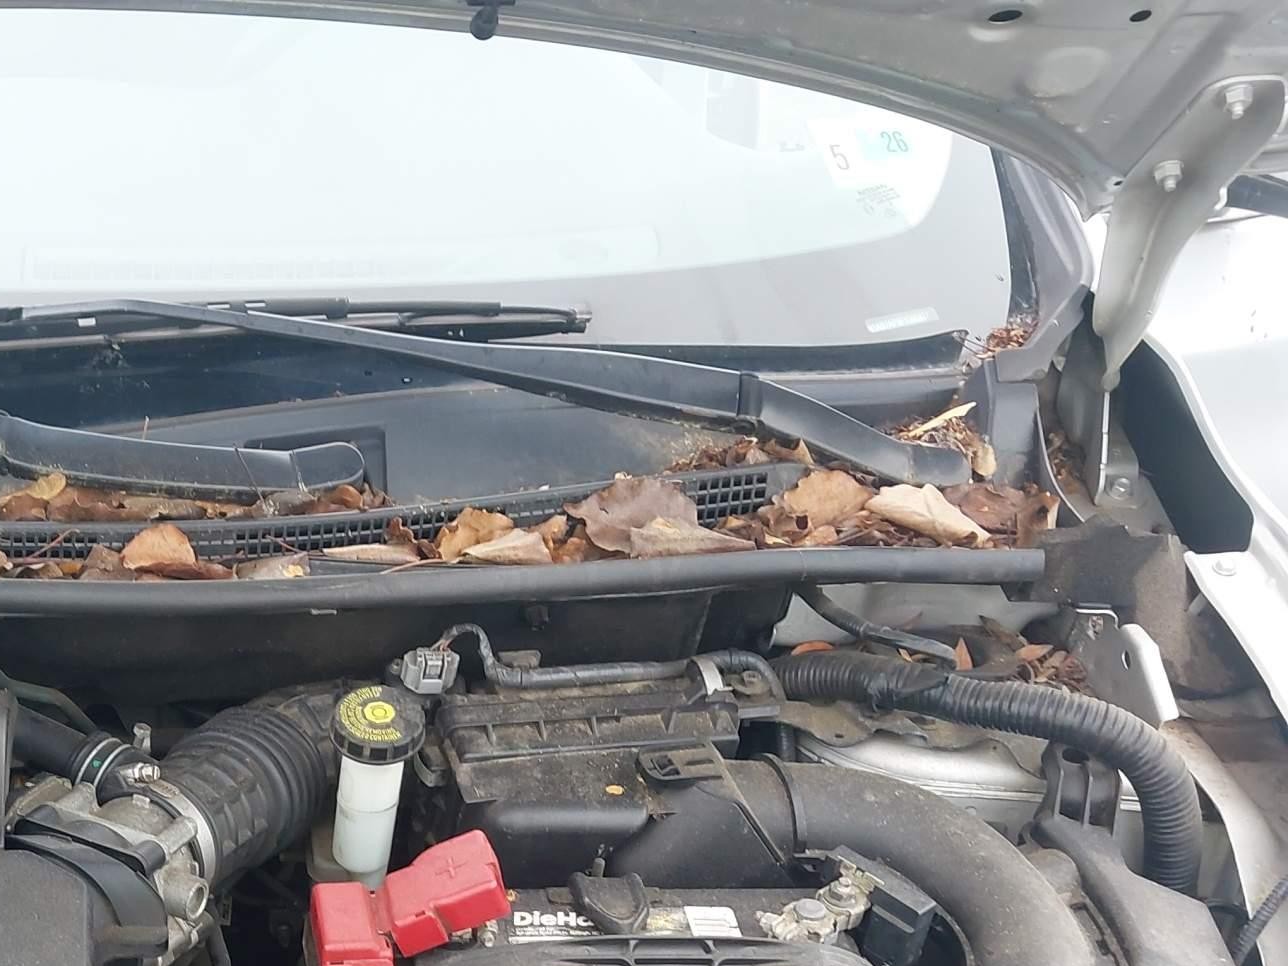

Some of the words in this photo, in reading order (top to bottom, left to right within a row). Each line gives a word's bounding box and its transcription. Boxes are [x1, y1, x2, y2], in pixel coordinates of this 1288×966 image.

[879, 130, 910, 153] 26
[829, 144, 850, 171] 5
[513, 911, 595, 927] DieHa
